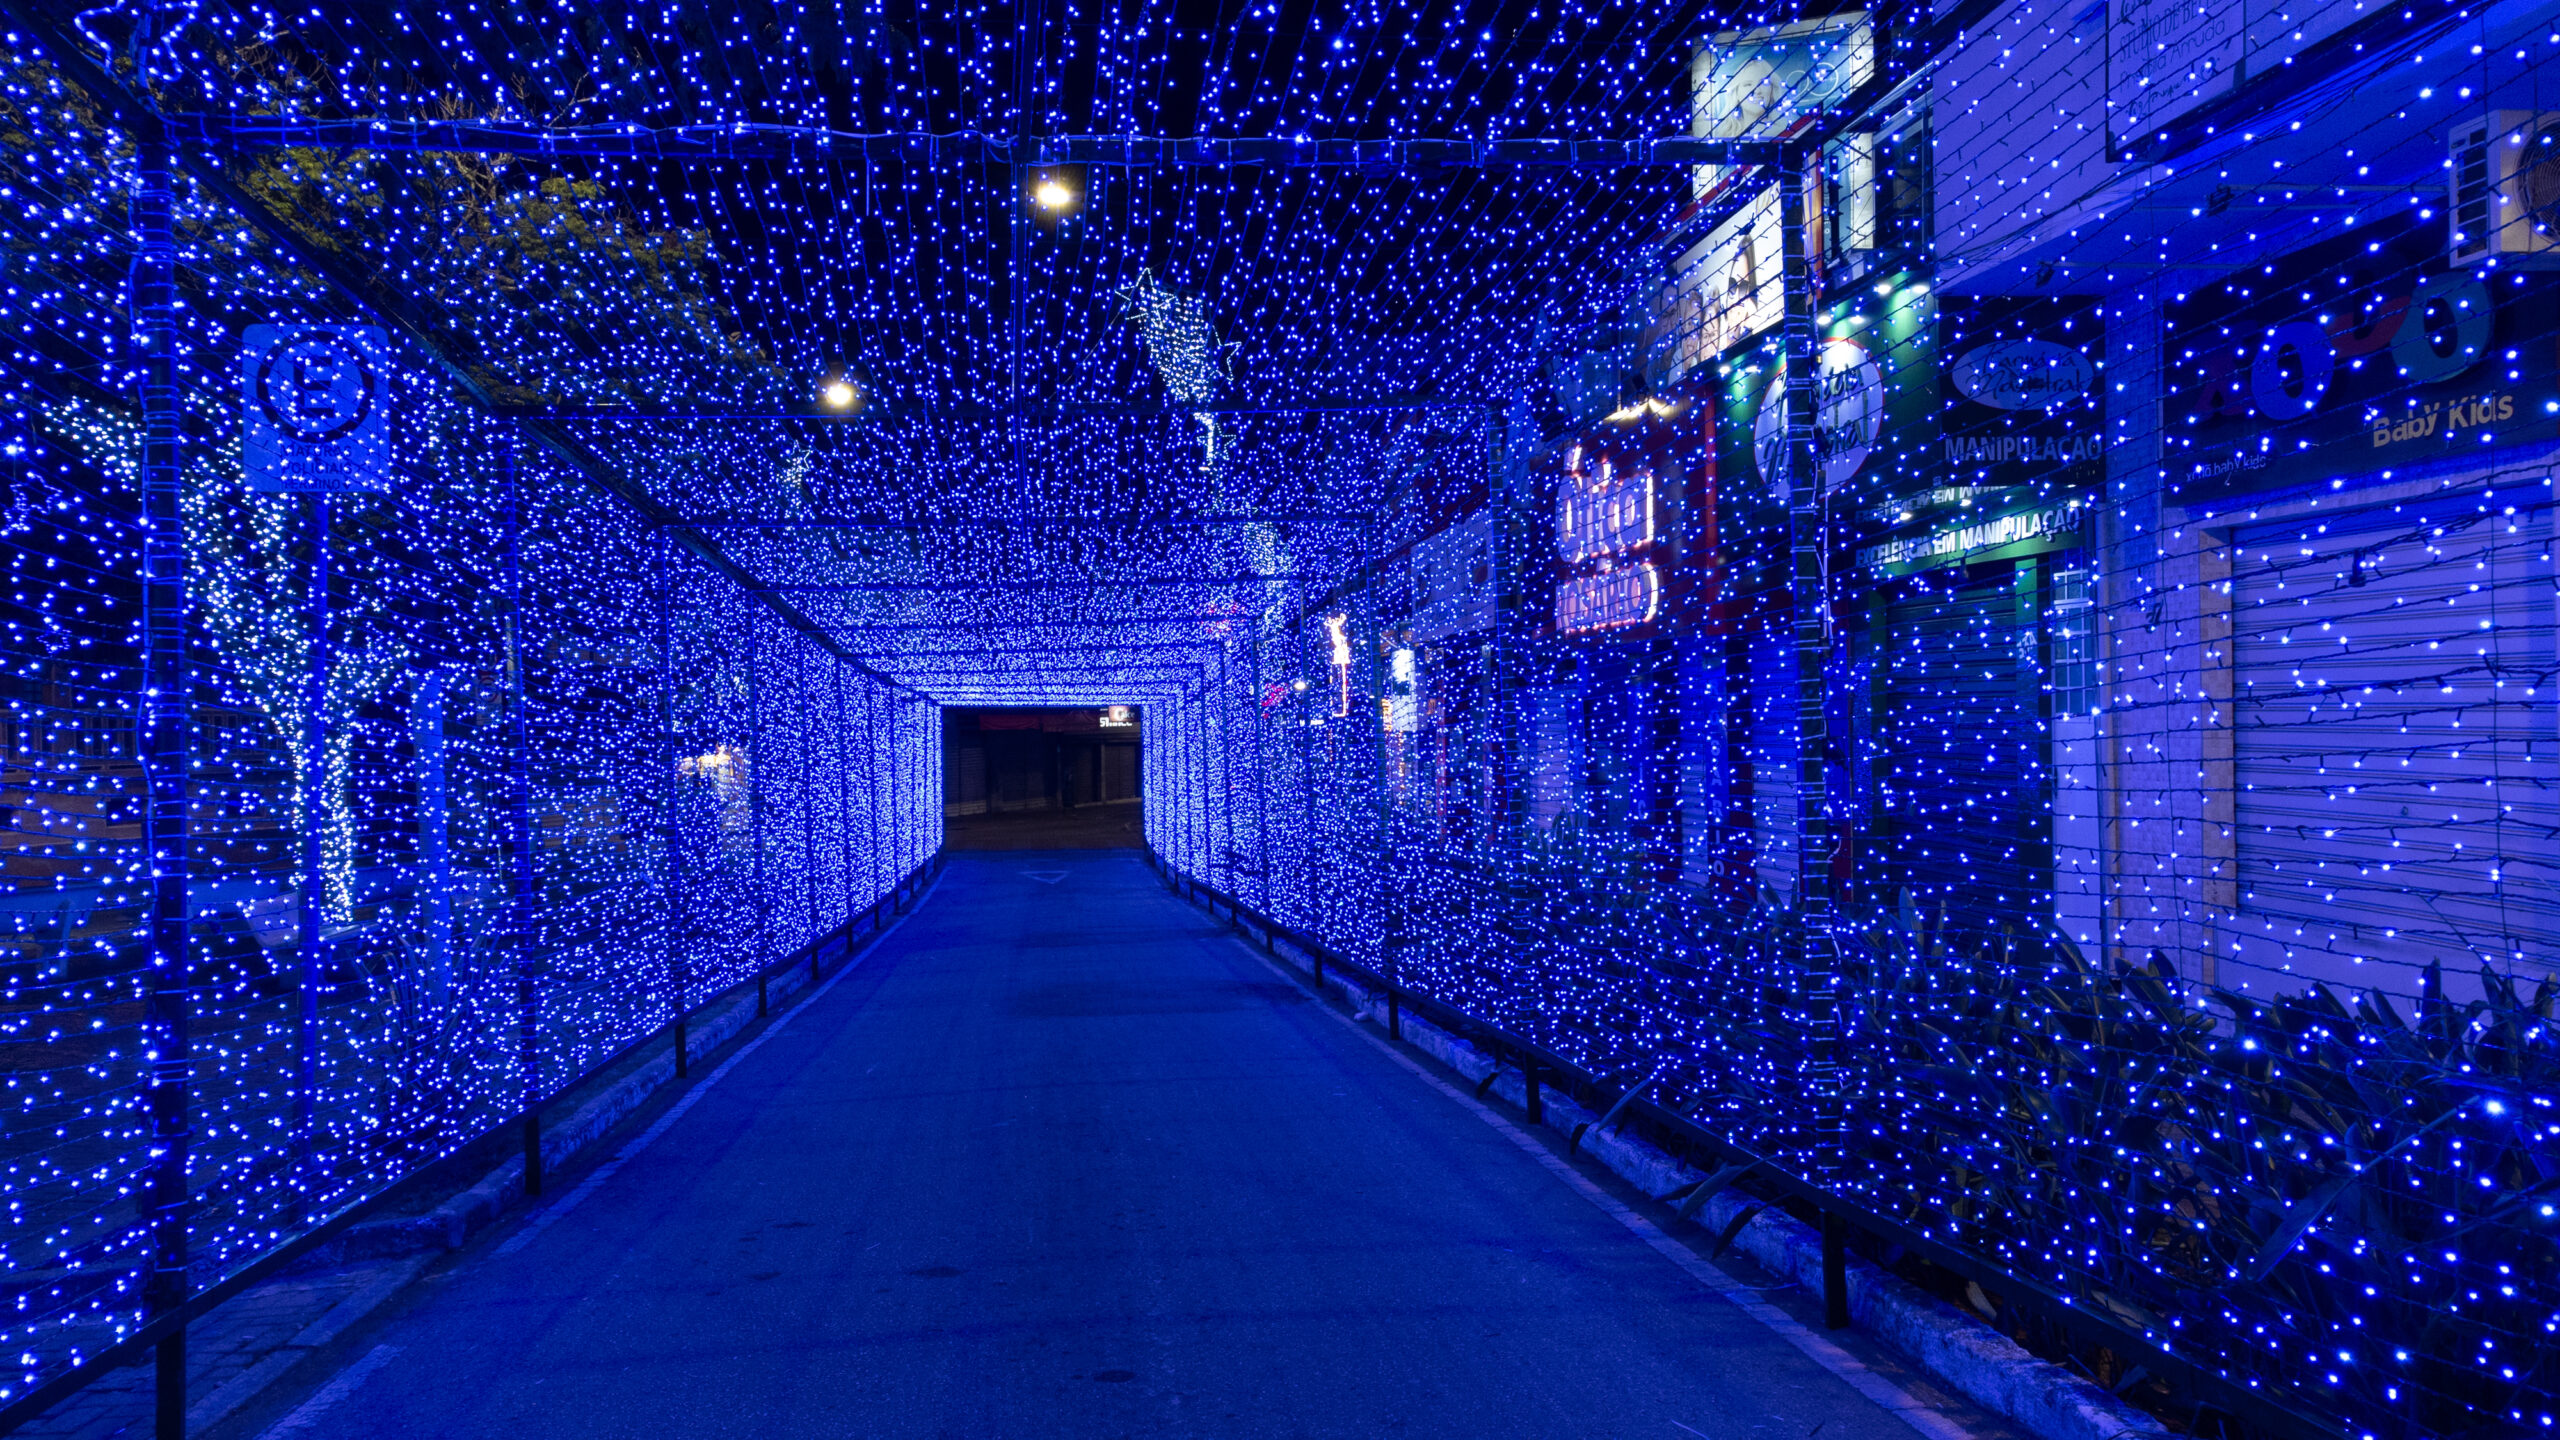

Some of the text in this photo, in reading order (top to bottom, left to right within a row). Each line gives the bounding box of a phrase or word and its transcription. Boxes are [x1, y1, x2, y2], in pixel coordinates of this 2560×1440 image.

[2171, 18, 2225, 62] Arruda
[2374, 394, 2513, 448] Baby Kids
[1855, 502, 2080, 567] EXCELÊNCIA EM MANIPULAÇÃO
